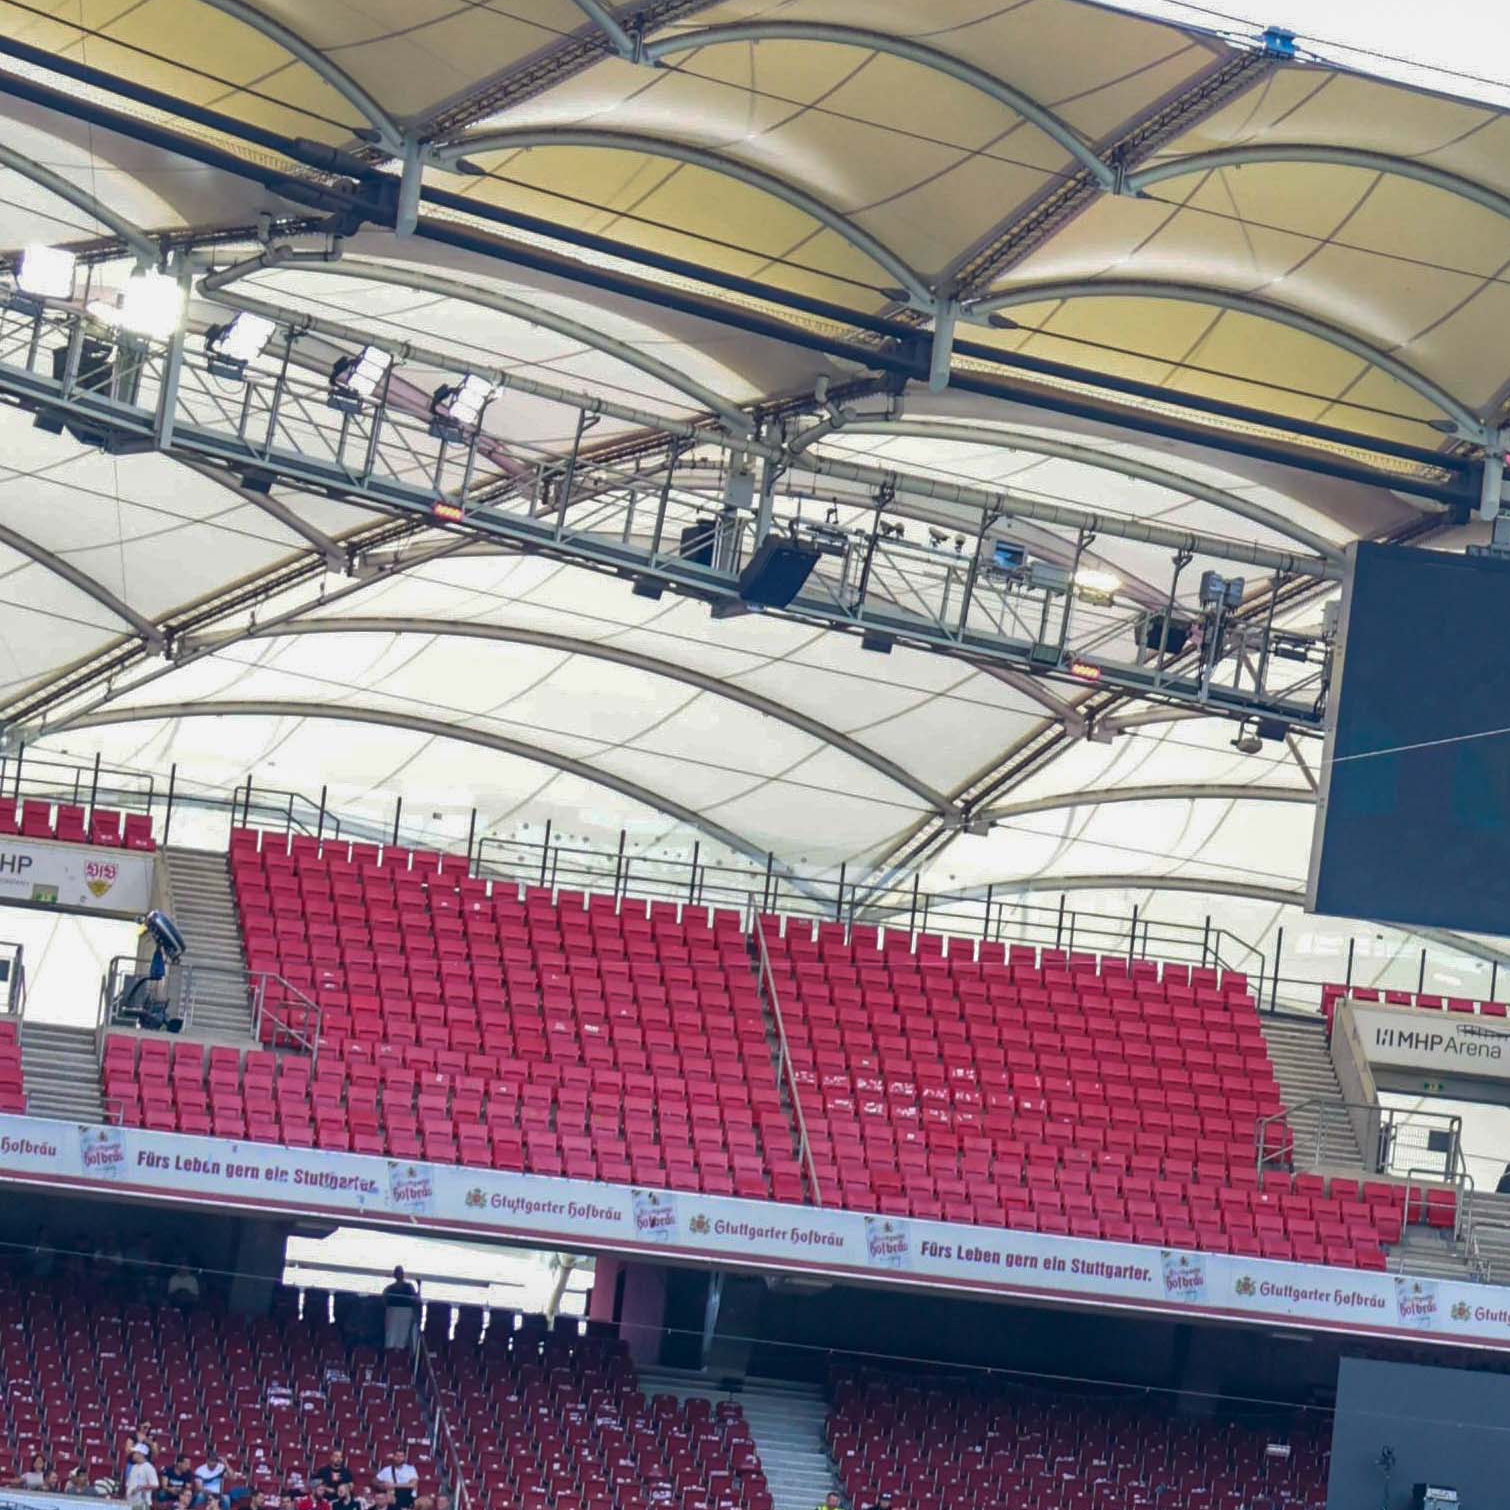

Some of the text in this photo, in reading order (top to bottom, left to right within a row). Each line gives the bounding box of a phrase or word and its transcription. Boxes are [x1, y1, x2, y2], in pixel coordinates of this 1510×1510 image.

[1398, 1032, 1502, 1059] MHP Arena
[920, 1240, 952, 1259] Fürs
[957, 1245, 1001, 1264] Leben
[1006, 1253, 1038, 1272] gern
[1043, 1253, 1066, 1271] ein
[1071, 1258, 1152, 1283] Stuttgarter.
